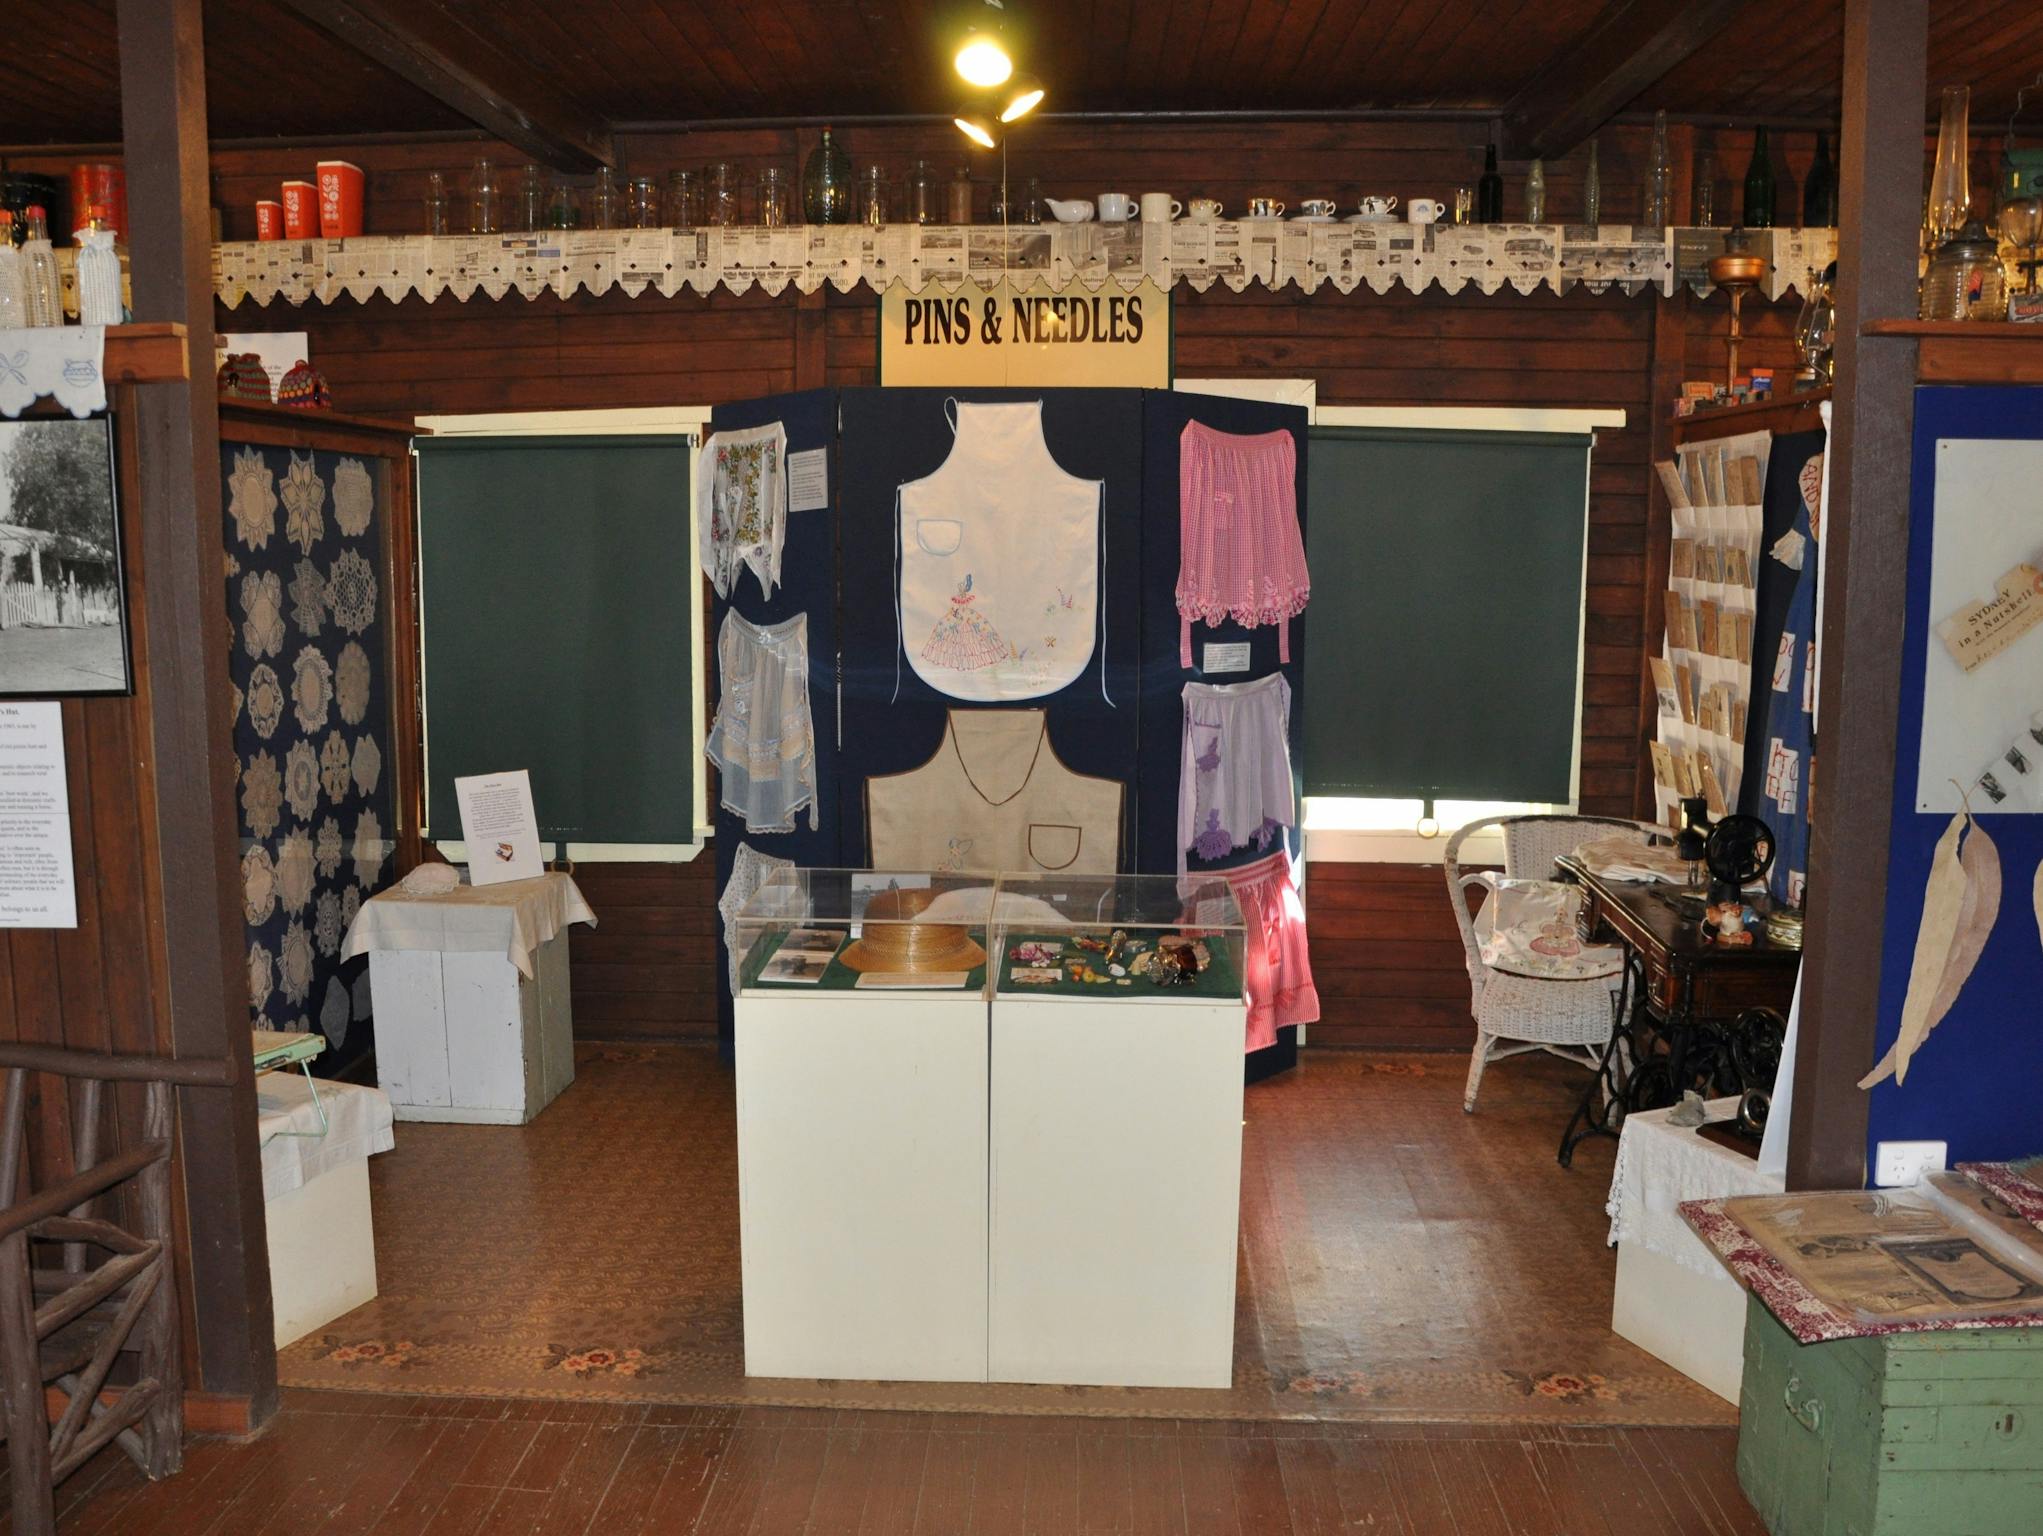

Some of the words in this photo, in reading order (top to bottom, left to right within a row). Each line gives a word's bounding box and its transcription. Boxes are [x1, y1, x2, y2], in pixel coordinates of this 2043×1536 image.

[905, 297, 971, 345] PINS
[980, 296, 1002, 345] &
[1012, 295, 1144, 344] NEEDLES
[1968, 588, 2010, 627] SYDNEY
[1983, 588, 2033, 630] Nutshell
